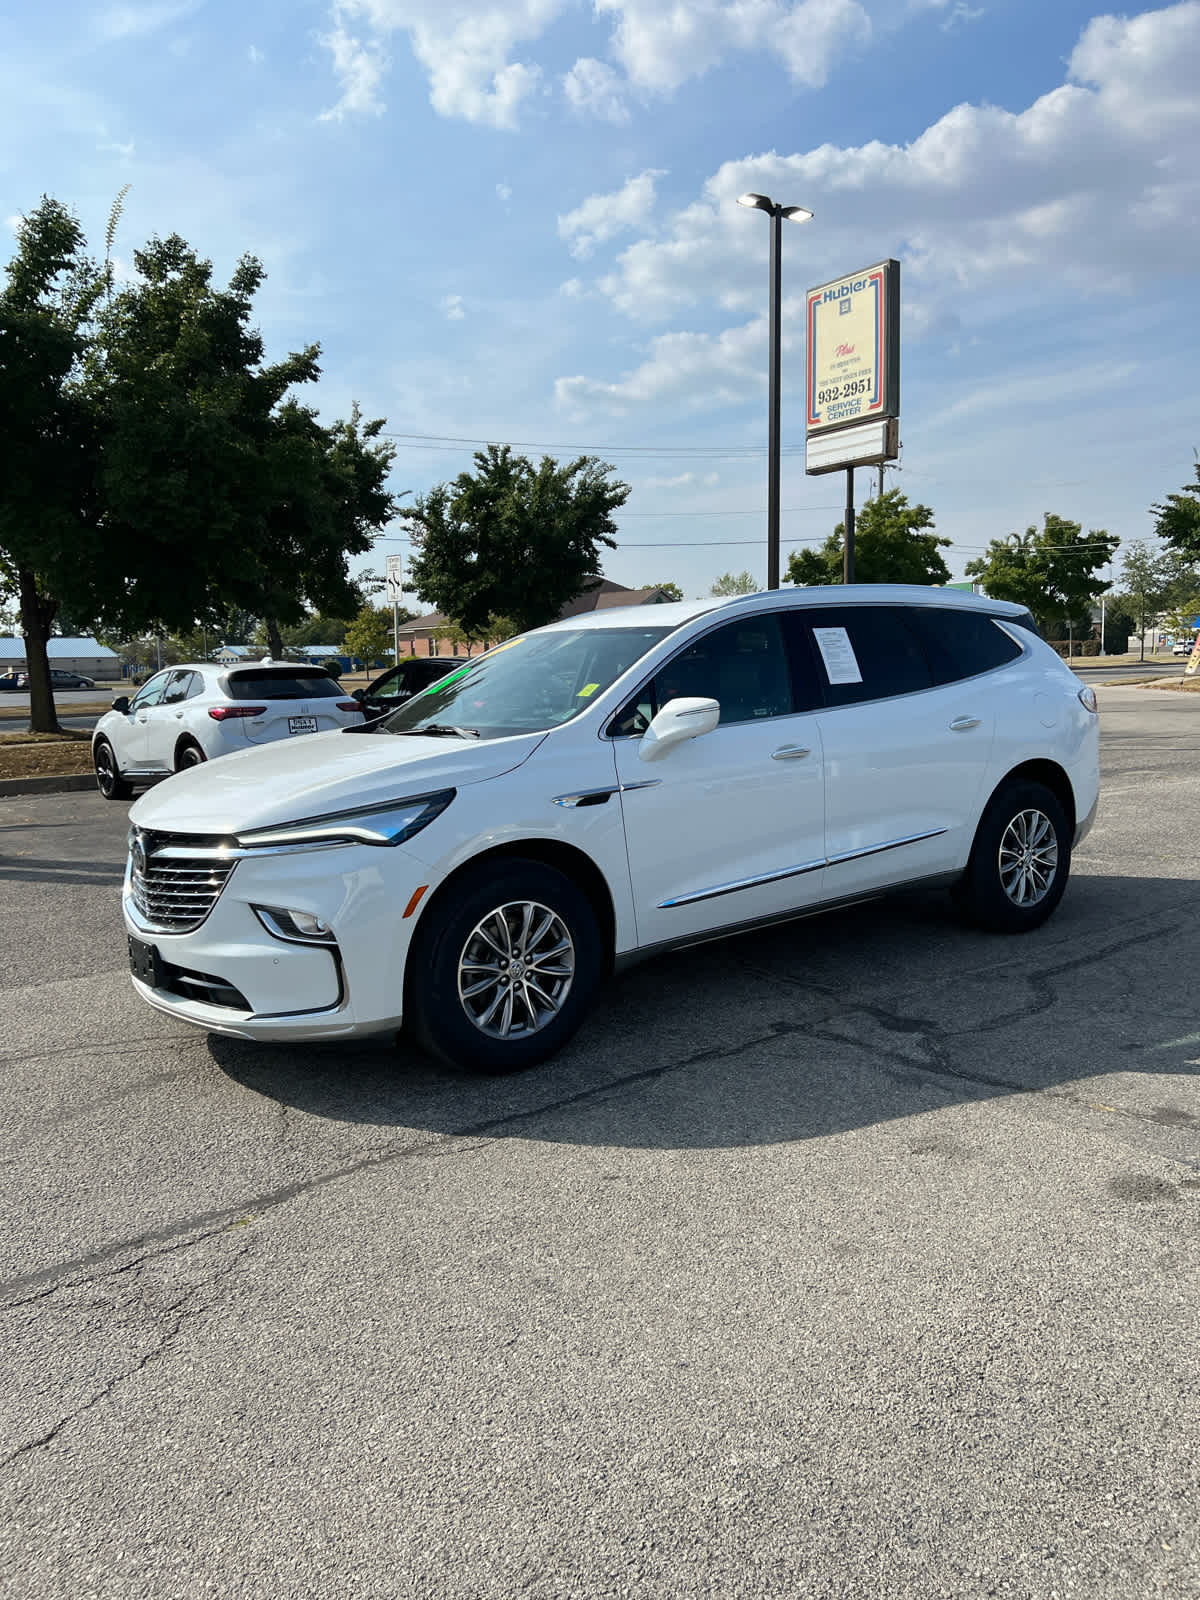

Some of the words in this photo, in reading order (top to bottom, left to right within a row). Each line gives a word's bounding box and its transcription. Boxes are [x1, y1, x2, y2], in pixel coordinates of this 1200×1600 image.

[823, 279, 868, 303] Hubler
[818, 377, 872, 405] 932-2951
[826, 397, 862, 412] SERVICE
[827, 406, 861, 421] CENTER
